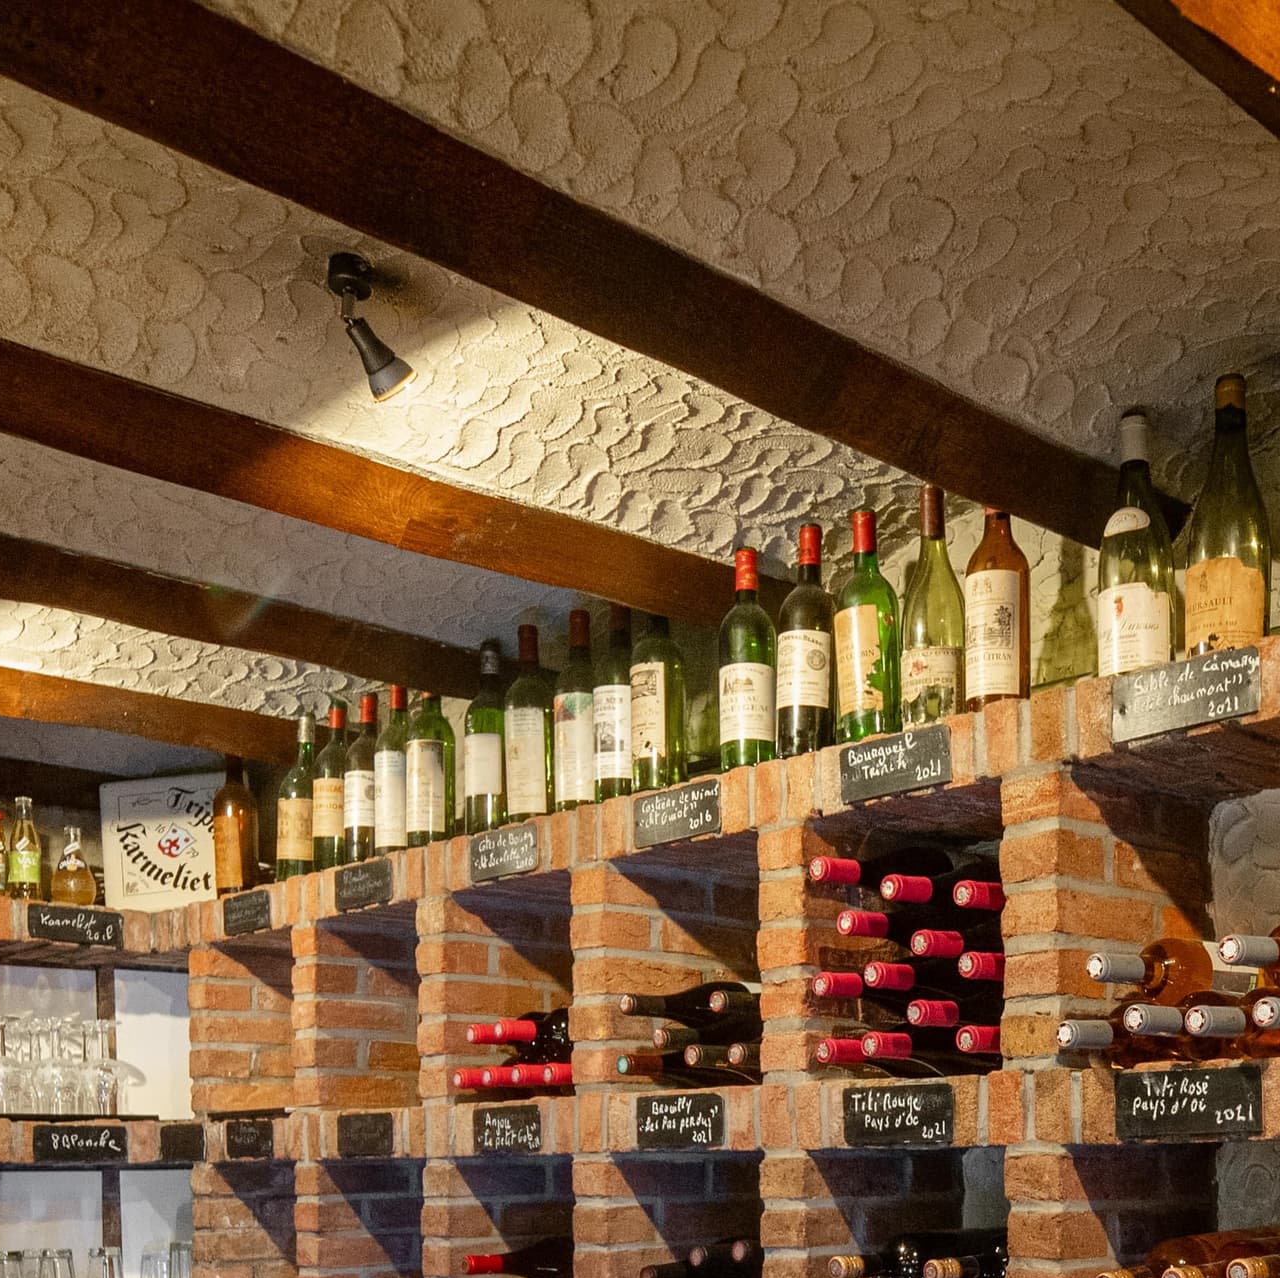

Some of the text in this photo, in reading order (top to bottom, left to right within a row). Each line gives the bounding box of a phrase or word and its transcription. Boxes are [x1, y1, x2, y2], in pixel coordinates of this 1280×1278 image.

[1207, 695, 1239, 718] 2021
[848, 732, 918, 767] Bourgueil
[915, 759, 941, 781] 2021
[687, 810, 712, 830] 2016
[116, 821, 213, 894] Karmeliet
[851, 1089, 881, 1112] Titi
[1132, 1097, 1165, 1120] Pays
[864, 1114, 890, 1131] Pays
[1215, 1103, 1253, 1124] 2021
[922, 1119, 946, 1139] 2021
